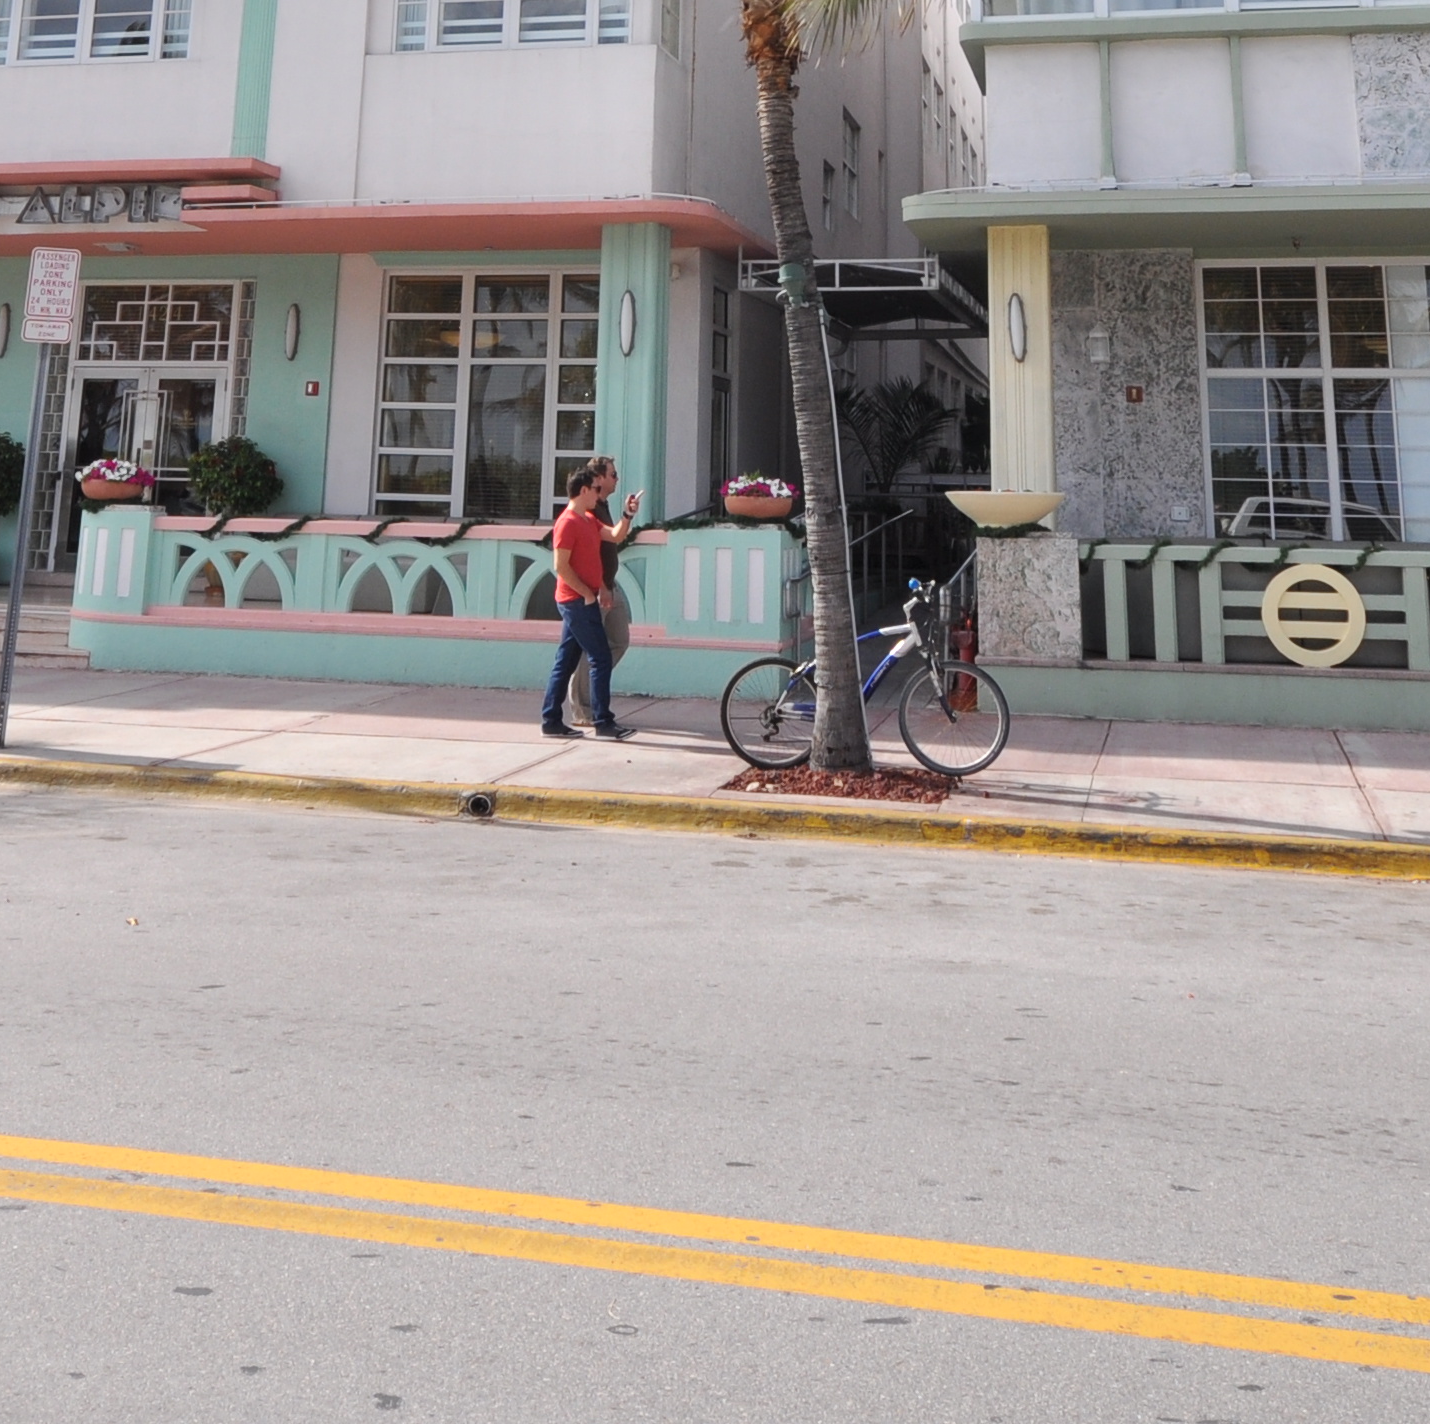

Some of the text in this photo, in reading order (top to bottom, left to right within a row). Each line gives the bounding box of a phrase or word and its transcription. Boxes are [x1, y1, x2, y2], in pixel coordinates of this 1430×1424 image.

[37, 252, 75, 262] PASSENGER
[40, 262, 70, 270] LOADING
[43, 270, 64, 279] ZONE
[33, 279, 73, 288] PARKING
[40, 288, 63, 296] ONLY
[47, 298, 71, 306] HOURS
